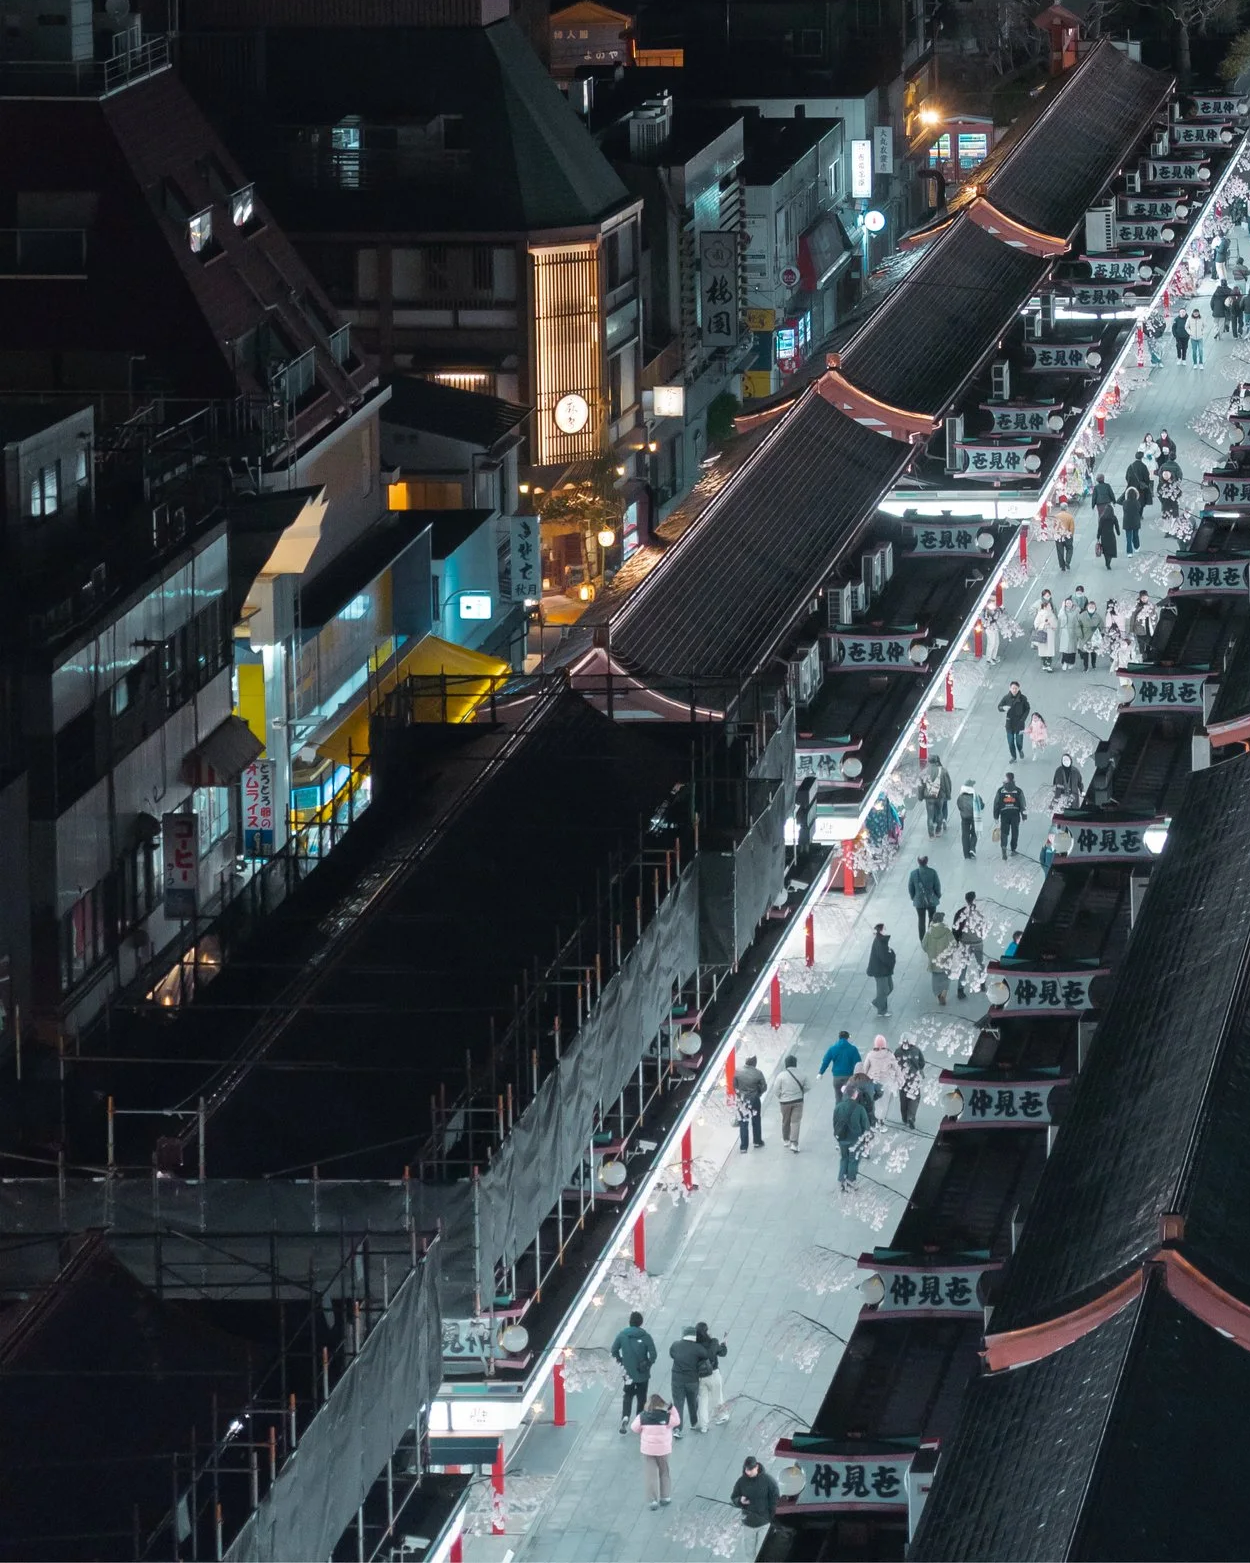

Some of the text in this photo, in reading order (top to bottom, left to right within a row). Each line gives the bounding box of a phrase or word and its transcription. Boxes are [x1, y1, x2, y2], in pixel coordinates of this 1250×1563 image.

[706, 275, 732, 336] 梅園
[516, 583, 537, 595] 秋月
[245, 763, 260, 828] オムライス
[260, 763, 272, 828] とろとろ卵の
[175, 820, 193, 881] コーヒー
